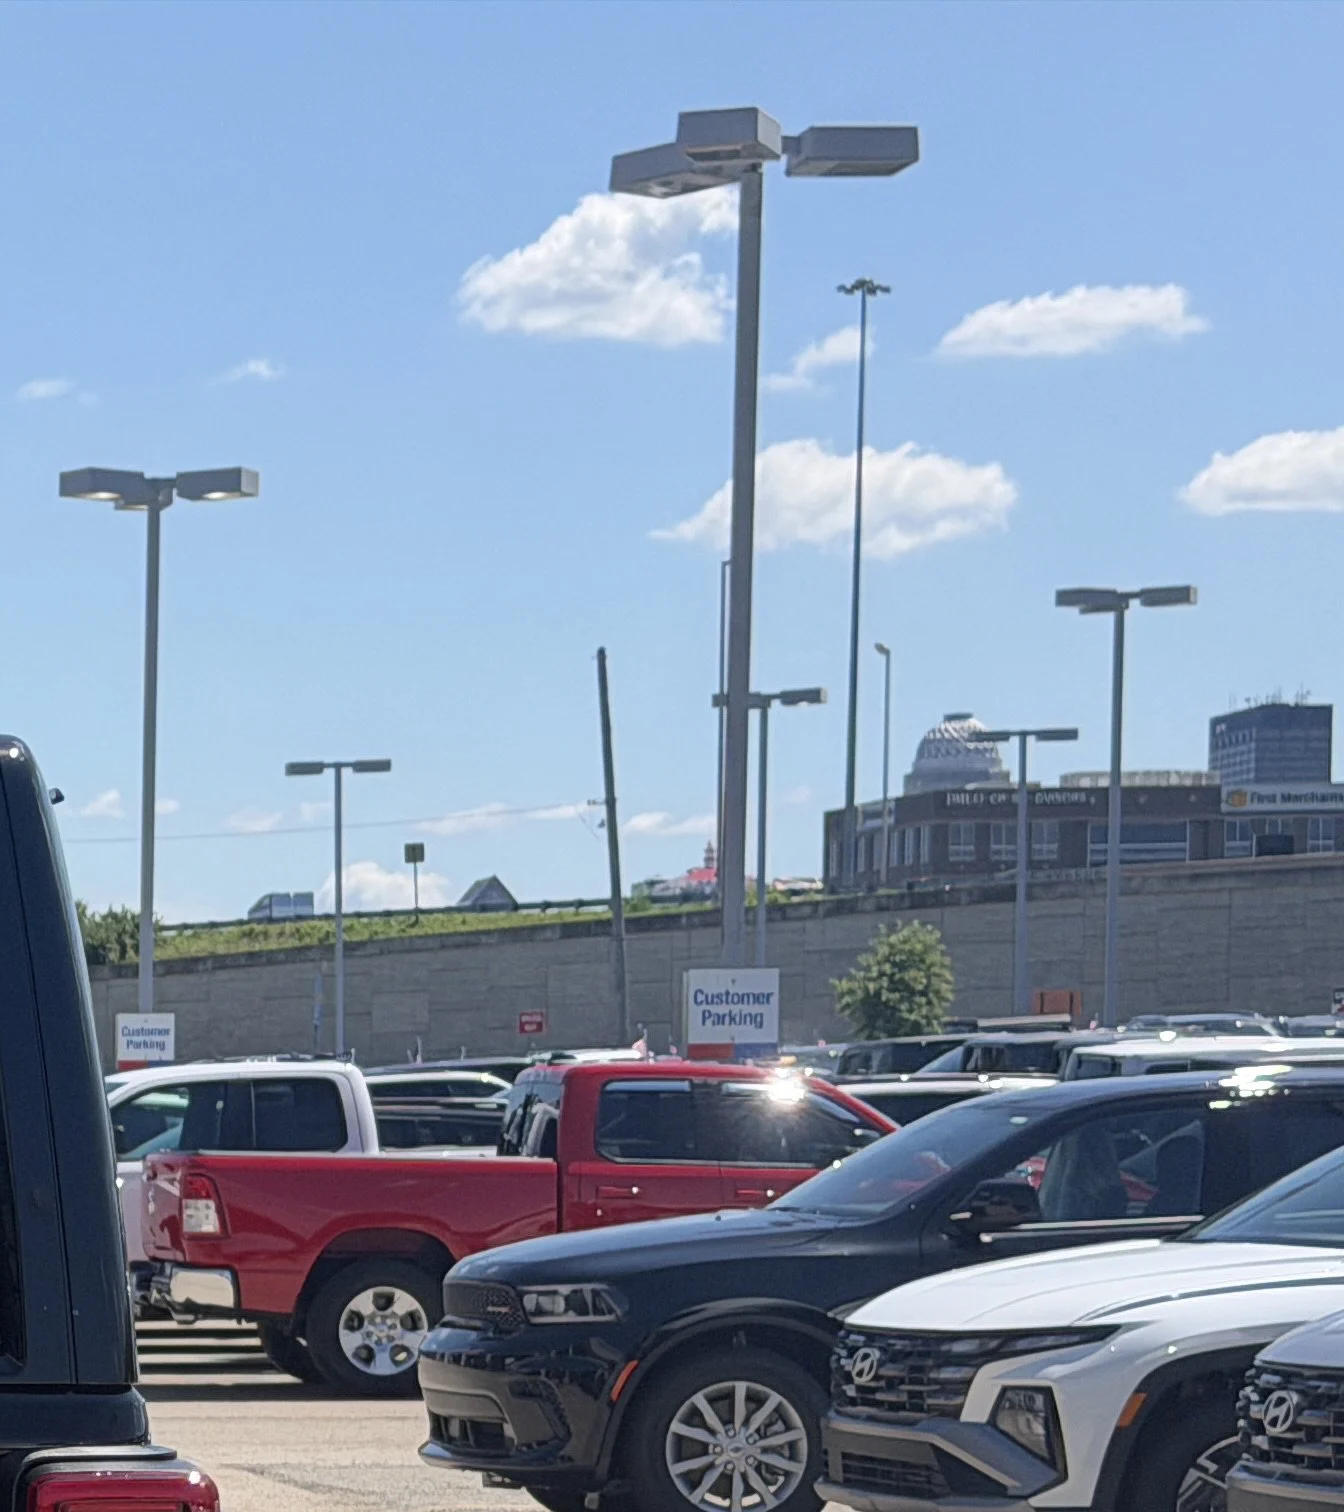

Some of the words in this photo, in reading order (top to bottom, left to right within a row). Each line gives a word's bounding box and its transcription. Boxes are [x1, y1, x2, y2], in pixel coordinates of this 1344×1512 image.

[693, 988, 774, 1006] Customer
[701, 1009, 764, 1029] Parking
[121, 1025, 171, 1037] Customer
[126, 1039, 166, 1051] Parking
